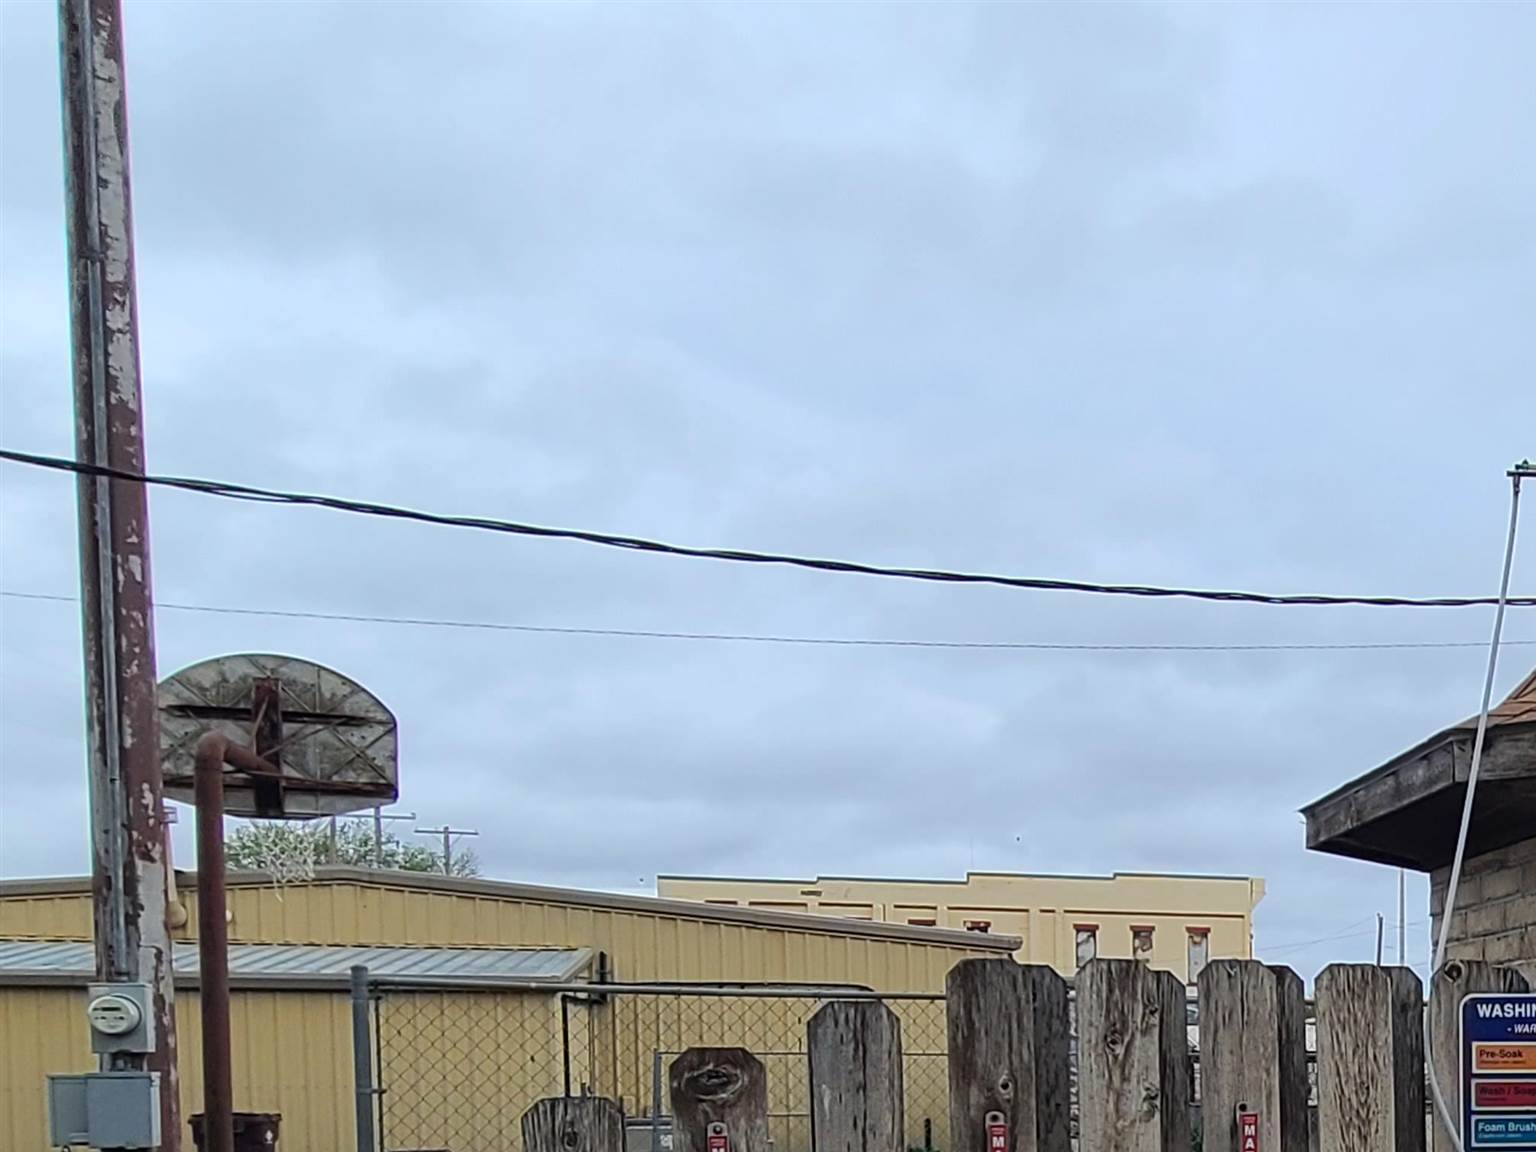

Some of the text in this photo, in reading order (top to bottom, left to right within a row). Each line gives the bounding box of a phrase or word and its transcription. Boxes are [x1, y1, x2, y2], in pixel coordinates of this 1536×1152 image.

[1479, 1049, 1523, 1058] Pre-Soak
[1478, 1122, 1536, 1132] Foam Brush
